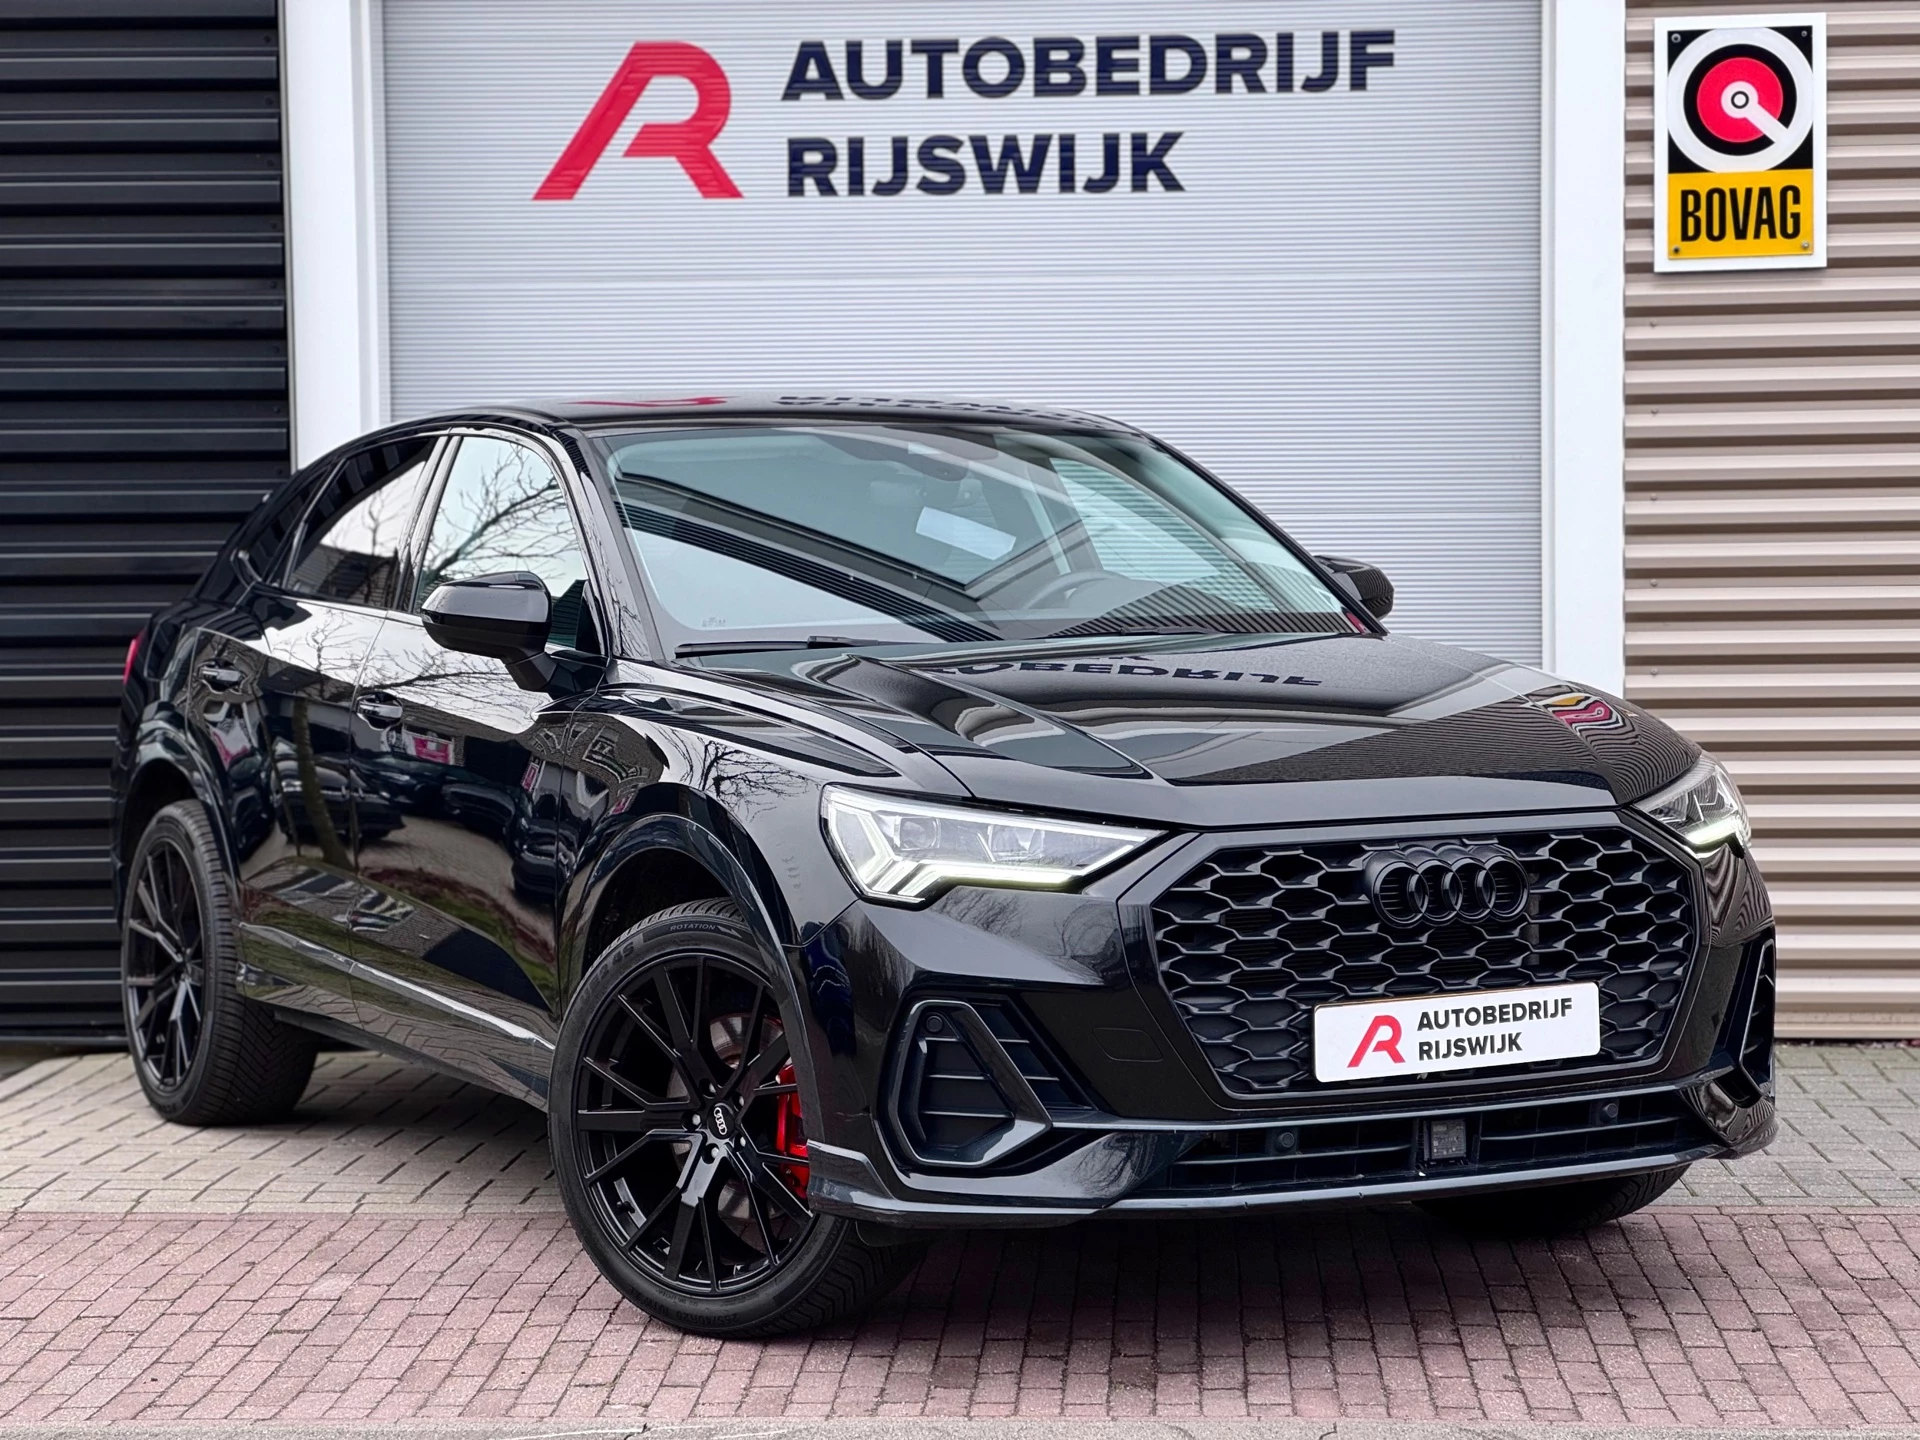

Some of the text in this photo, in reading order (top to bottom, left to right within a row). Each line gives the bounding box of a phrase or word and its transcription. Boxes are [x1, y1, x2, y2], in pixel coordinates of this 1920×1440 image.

[782, 30, 1395, 101] AUTOBEDRIJF
[787, 131, 1185, 197] RIJSWIJK
[1680, 185, 1801, 242] BOVAG
[669, 922, 717, 932] ROTATION
[1417, 998, 1572, 1030] AUTOBEDRIJF
[1418, 1032, 1522, 1061] RIJSWIJK
